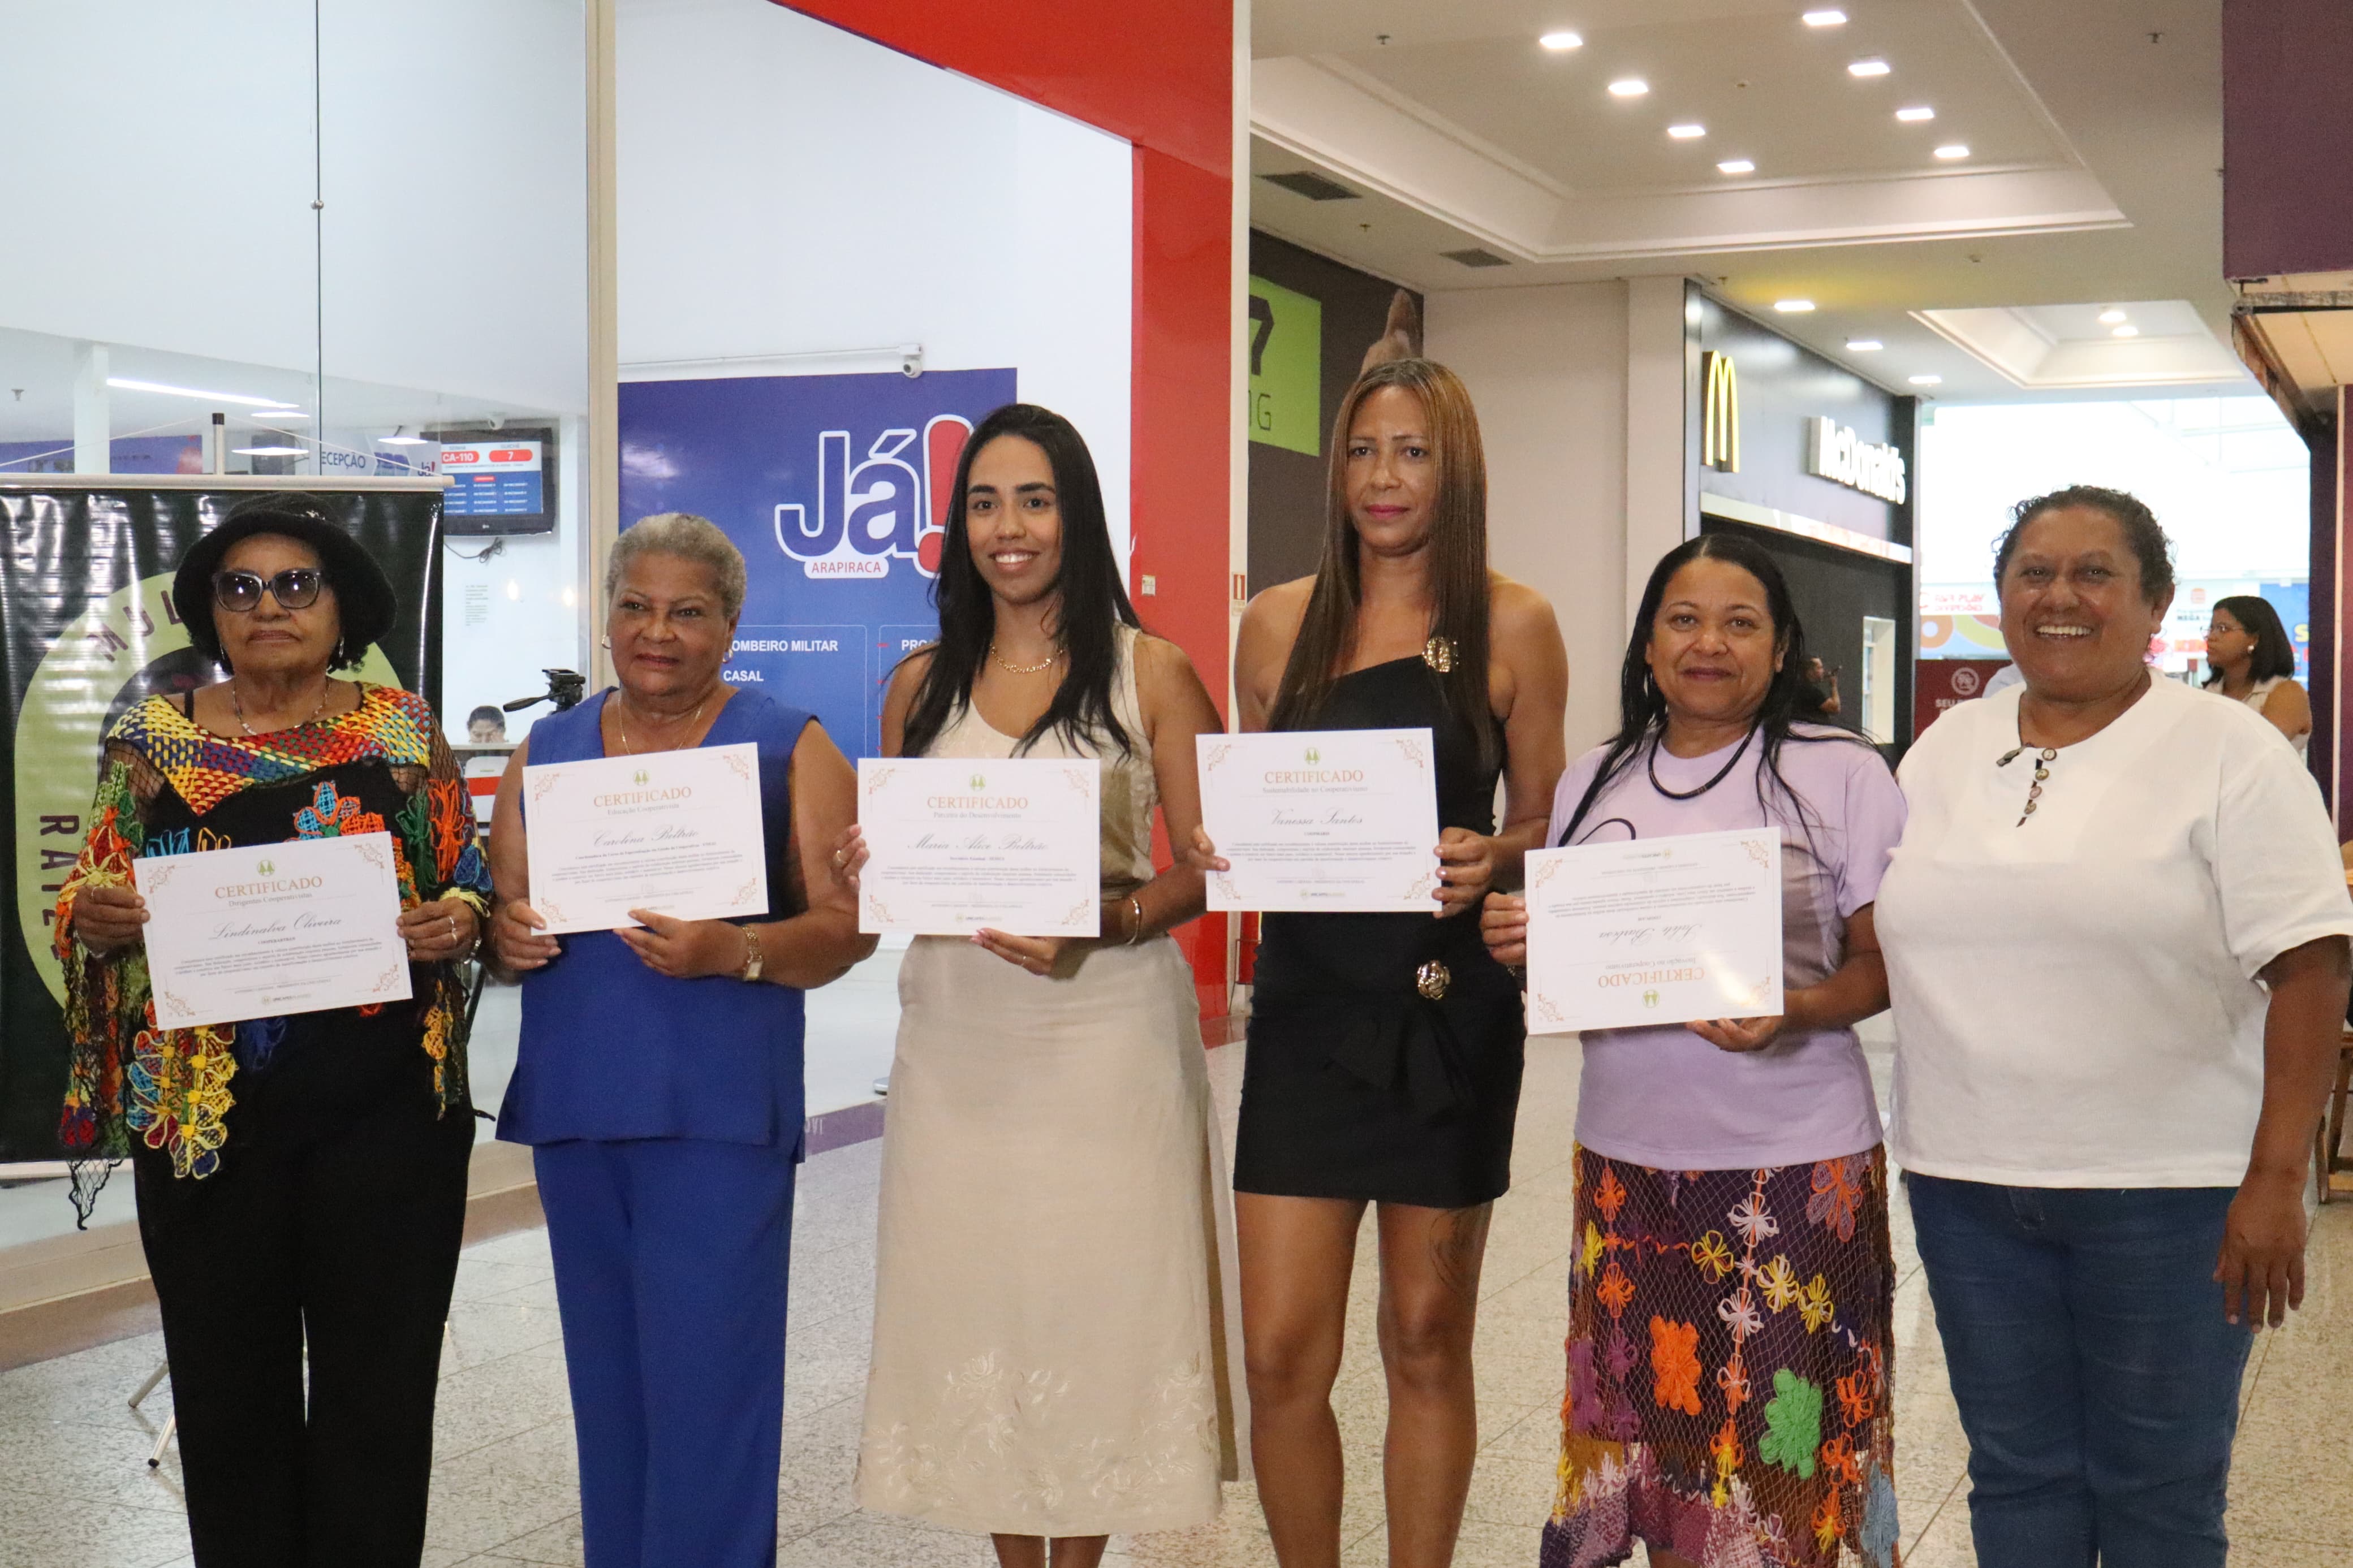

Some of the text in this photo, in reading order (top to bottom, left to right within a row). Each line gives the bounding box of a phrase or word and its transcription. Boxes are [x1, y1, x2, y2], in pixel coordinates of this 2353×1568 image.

[321, 451, 366, 469] ECEPÇÃO
[442, 452, 514, 462] CA-110 7
[812, 561, 881, 574] ARAPIRACA
[731, 640, 838, 651] OMBEIRO MILITAR
[723, 670, 764, 682] CASAL
[1265, 770, 1364, 784] CERTIFICADO
[593, 787, 692, 807] CERTIFICADO
[926, 796, 1029, 809] CERTIFICADO
[1320, 807, 1363, 824] Santos
[215, 876, 322, 899] CERTIFICADO
[229, 893, 313, 907] Dirigentes Cooperativistas
[294, 912, 342, 930] Oliveira
[1598, 966, 1705, 988] CERTIFICADO
